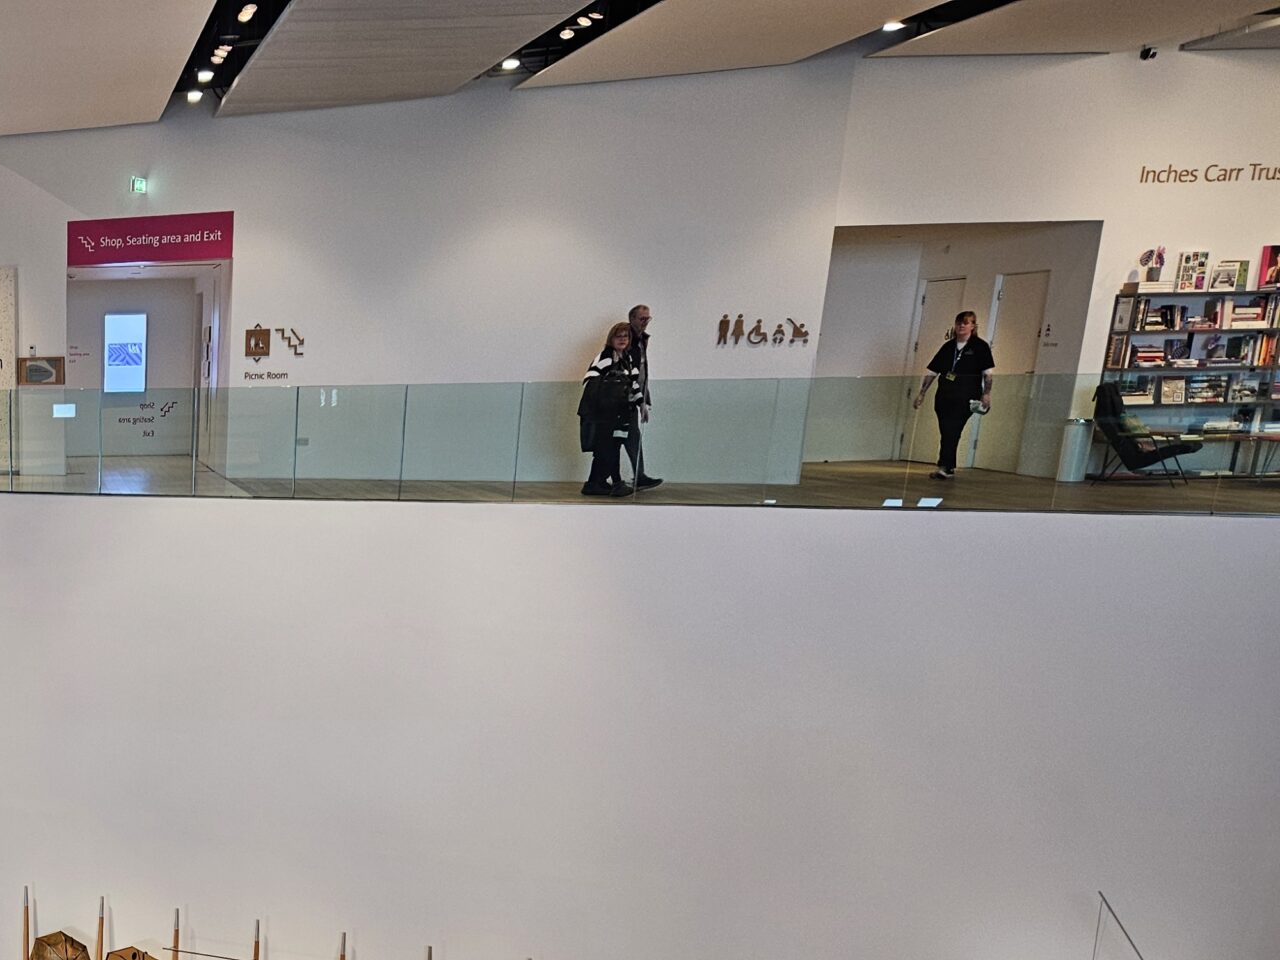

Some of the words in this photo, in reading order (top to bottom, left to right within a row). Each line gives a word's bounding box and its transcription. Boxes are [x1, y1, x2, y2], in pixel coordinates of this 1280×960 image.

[1139, 163, 1199, 183] Inches
[1204, 164, 1244, 182] Carr
[100, 236, 125, 249] Shop,
[126, 234, 160, 247] Seating
[161, 235, 182, 244] area
[183, 230, 202, 242] and
[203, 230, 222, 242] Exit
[244, 371, 265, 380] Picnic
[266, 371, 289, 380] Room
